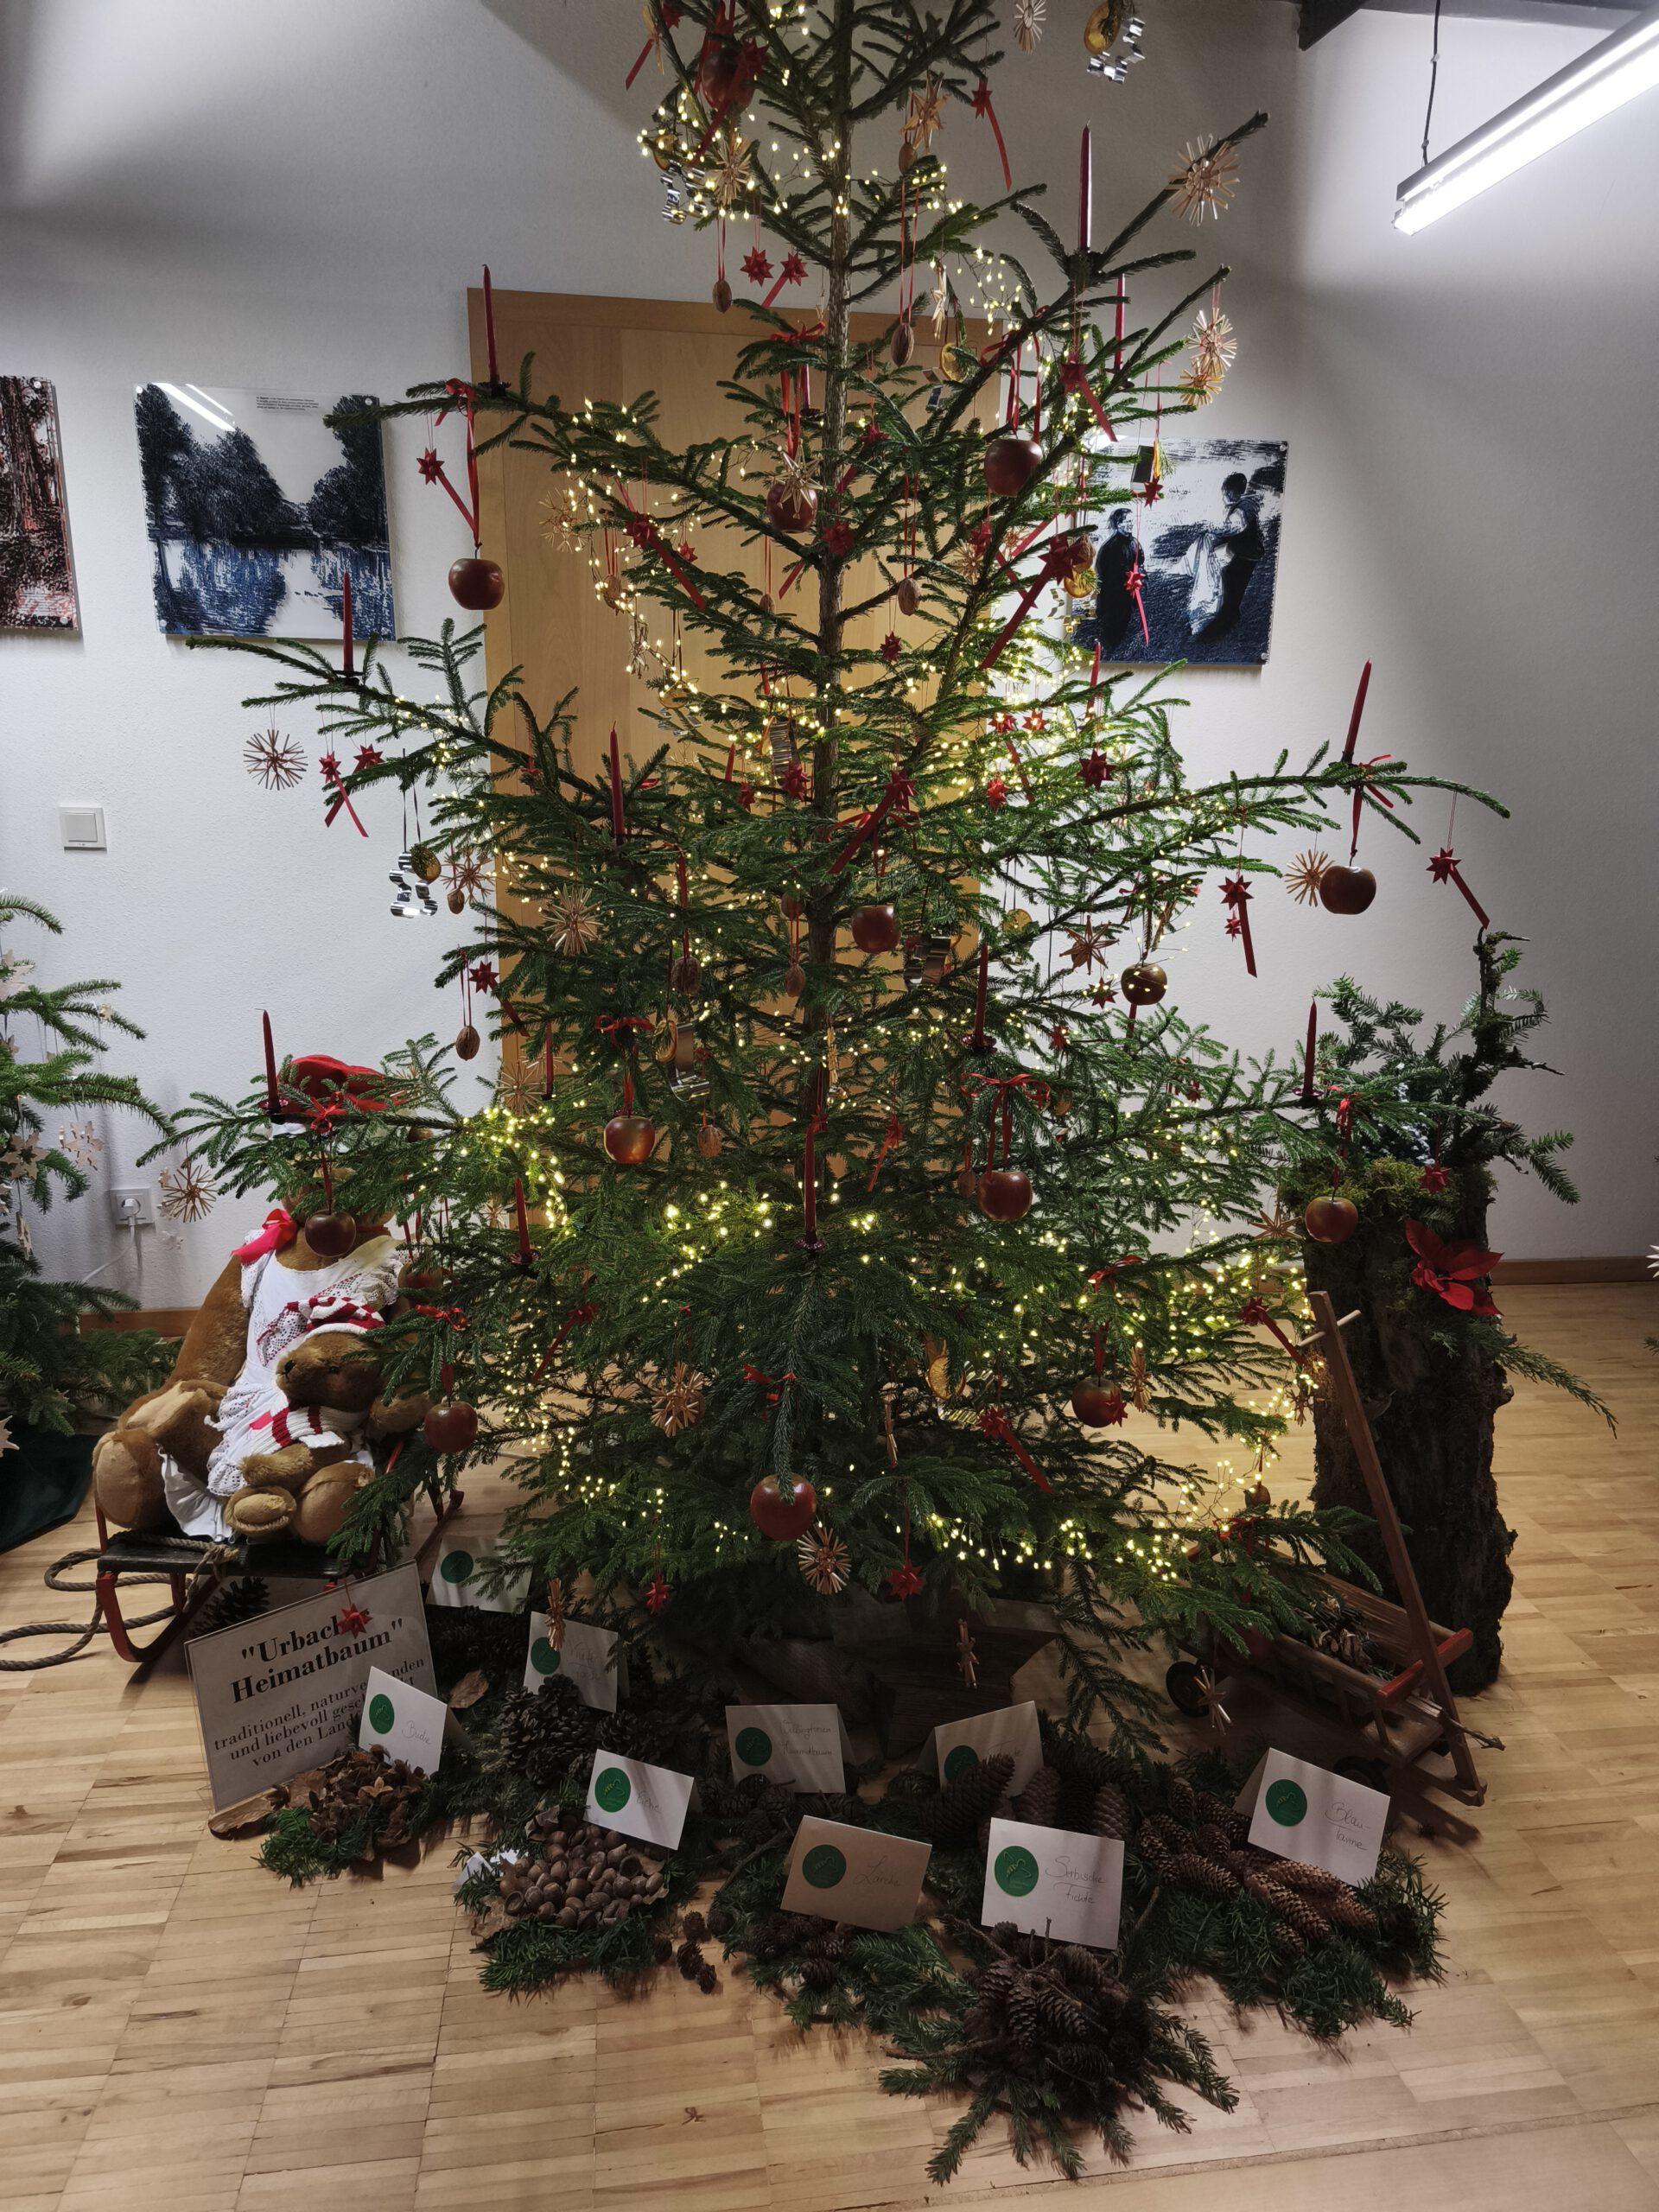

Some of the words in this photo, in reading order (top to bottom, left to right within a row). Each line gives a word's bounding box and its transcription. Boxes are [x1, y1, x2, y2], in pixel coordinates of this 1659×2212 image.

[231, 1618, 403, 1704] Heimatbaum"
[241, 1608, 370, 1662] "Urbac
[230, 1737, 260, 1760] und
[265, 1709, 328, 1746] liebevoll
[252, 1749, 282, 1767] von
[286, 1736, 314, 1754] den
